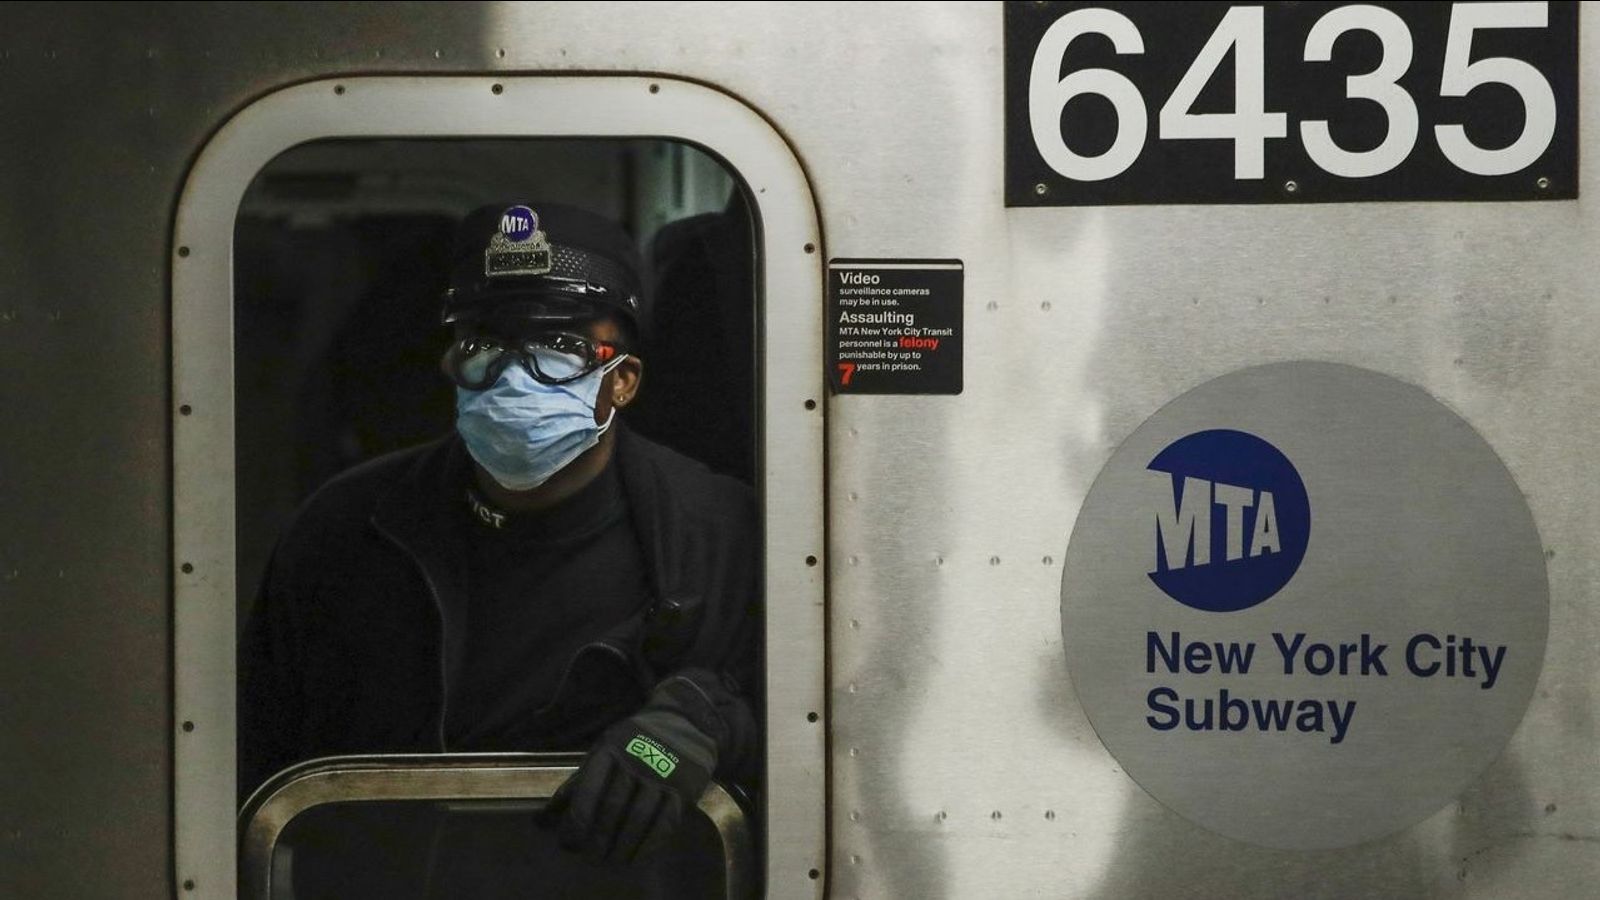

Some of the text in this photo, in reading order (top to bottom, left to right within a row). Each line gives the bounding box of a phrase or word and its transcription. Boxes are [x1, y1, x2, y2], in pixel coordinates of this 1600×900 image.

[1028, 2, 1557, 182] 6435
[501, 214, 530, 234] MTA
[839, 272, 880, 285] Video
[839, 287, 930, 296] surveillance cameras
[839, 297, 900, 307] may be in use.
[839, 311, 915, 327] Assaulting
[839, 327, 953, 337] MTA New York City Transit
[839, 339, 882, 349] personnel
[883, 339, 891, 348] is
[899, 336, 940, 351] felony
[839, 351, 921, 361] punishable by up to
[838, 362, 922, 386] 7 years in prison.
[1146, 468, 1282, 574] MTA
[1146, 631, 1507, 690] New York City
[1145, 686, 1357, 744] Subway
